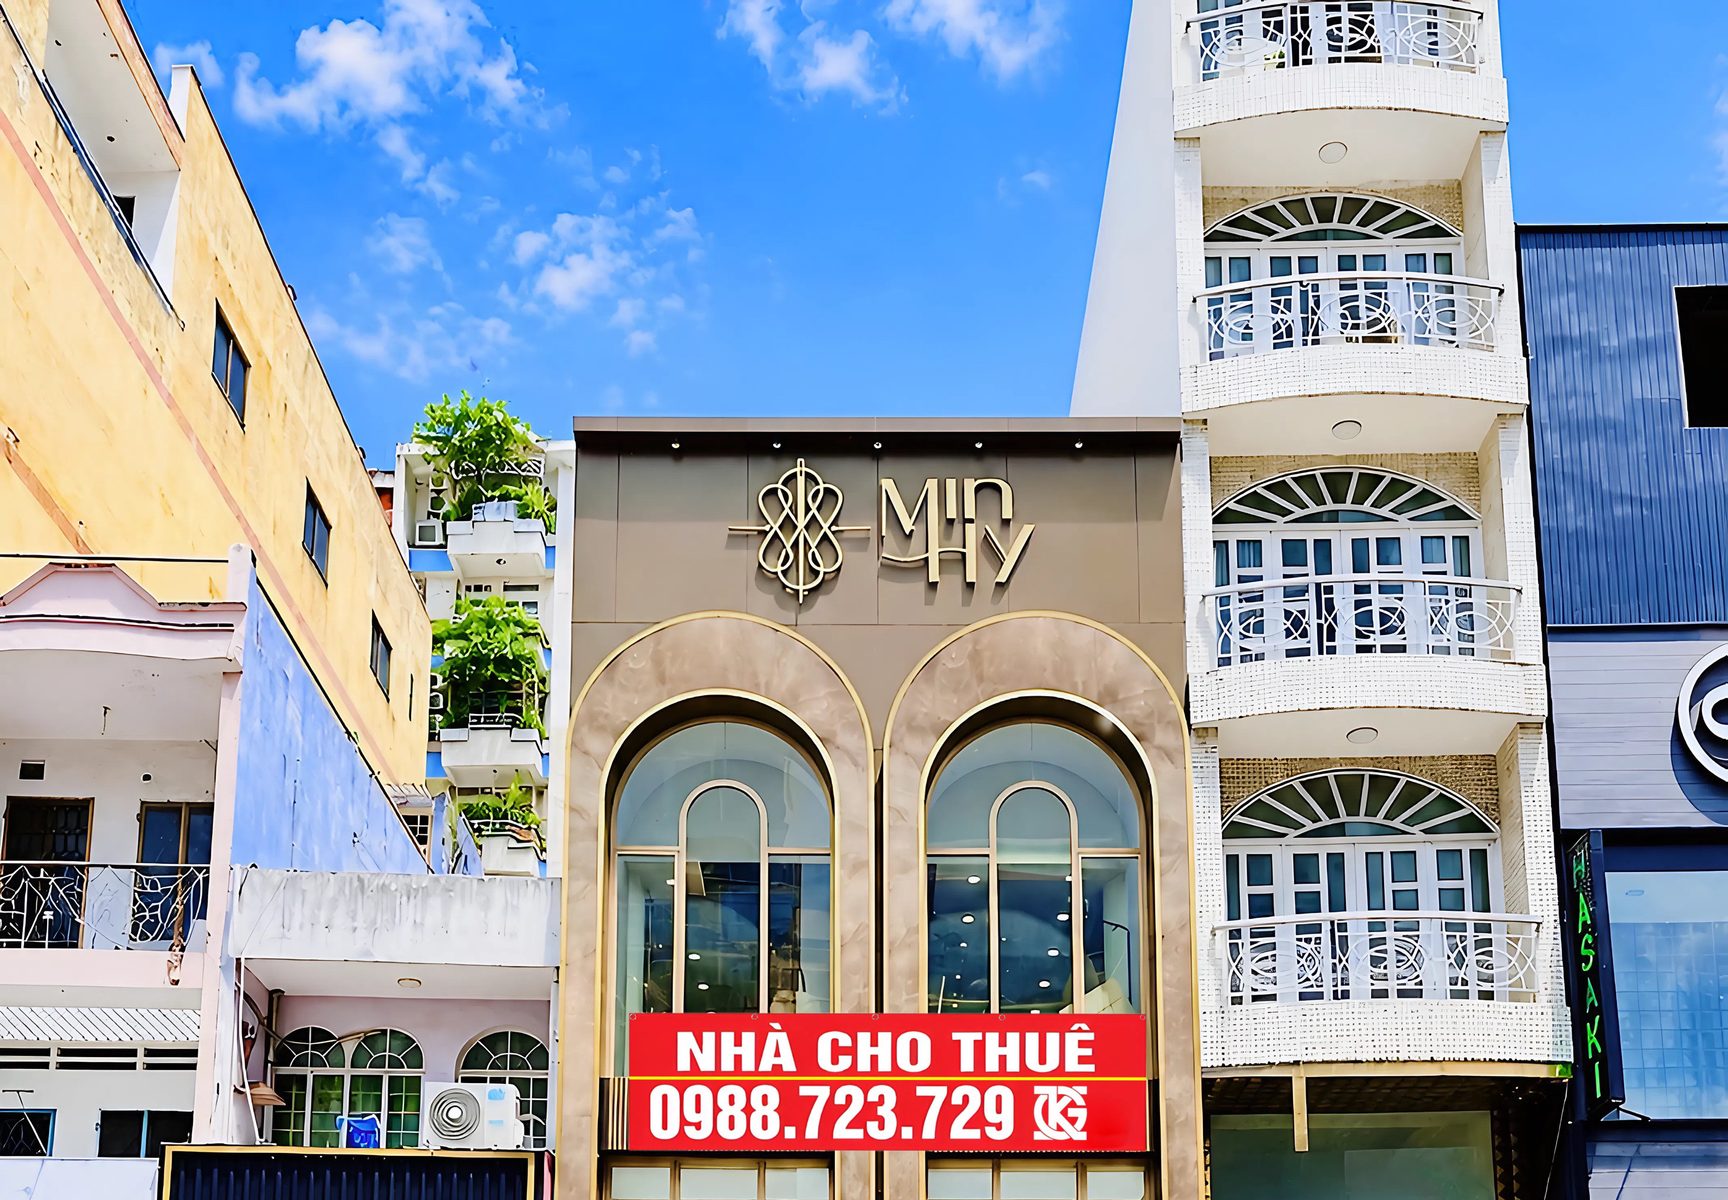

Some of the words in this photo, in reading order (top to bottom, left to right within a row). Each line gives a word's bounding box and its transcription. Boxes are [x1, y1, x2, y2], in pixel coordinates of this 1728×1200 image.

[1572, 850, 1602, 1098] HASAKI
[676, 1022, 797, 1072] NHÀ
[817, 1030, 932, 1073] CHO
[952, 1023, 1096, 1073] THUÊ
[649, 1084, 1015, 1141] 0988.723.729
